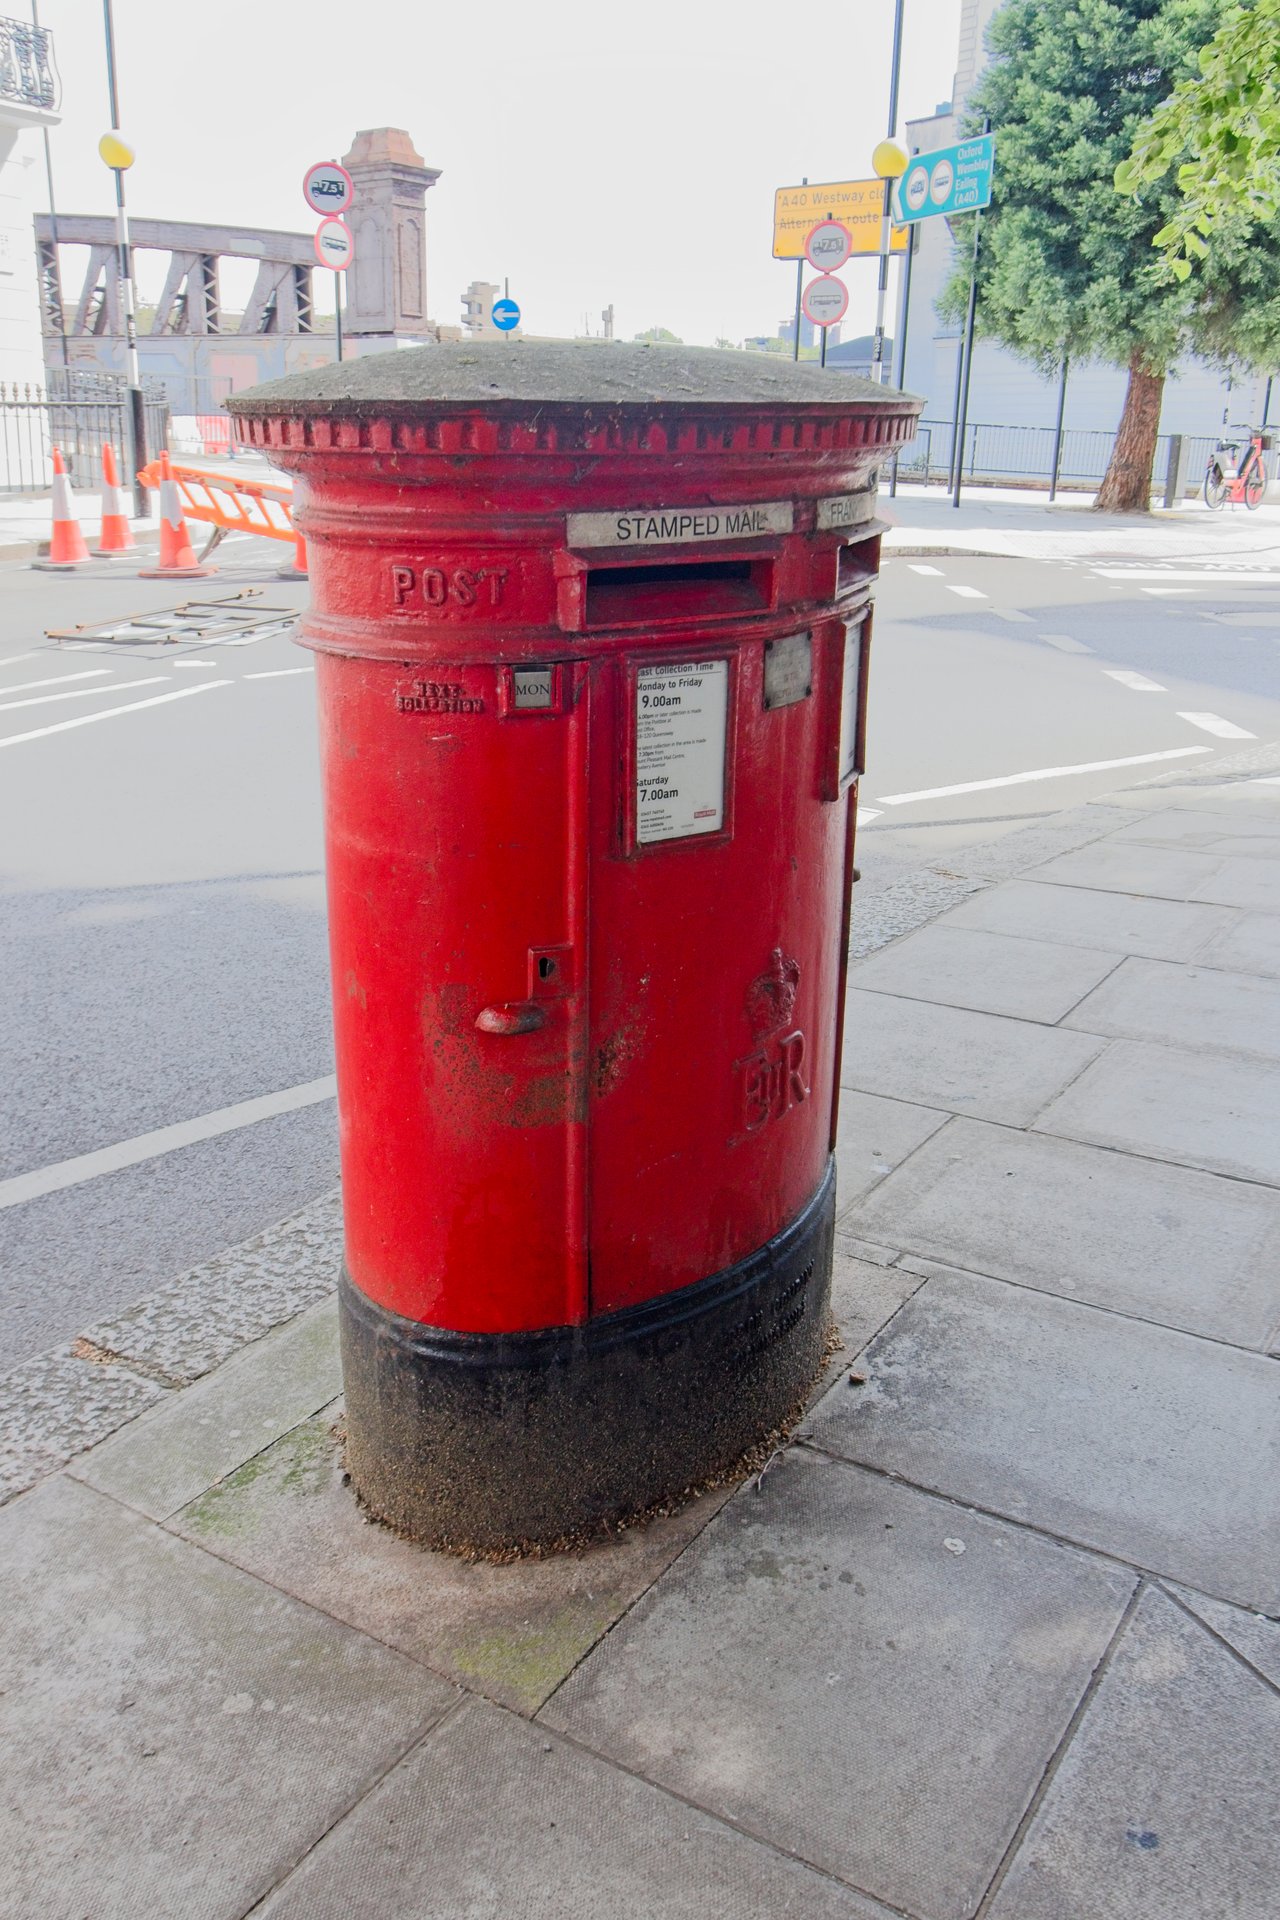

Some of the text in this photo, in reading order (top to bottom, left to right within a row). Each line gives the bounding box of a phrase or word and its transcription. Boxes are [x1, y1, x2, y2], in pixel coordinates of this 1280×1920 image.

[781, 193, 808, 208] A40
[812, 189, 865, 206] Westway
[846, 212, 880, 225] route
[616, 510, 766, 541] STAMPED MAIL
[391, 564, 509, 606] POST
[655, 664, 693, 675] Collection
[695, 662, 714, 671] Time
[516, 684, 551, 697] MON
[637, 678, 703, 691] Monday to Friday
[642, 695, 681, 709] 9.00am
[636, 776, 669, 787] Saturday
[640, 789, 679, 803] 7.00am
